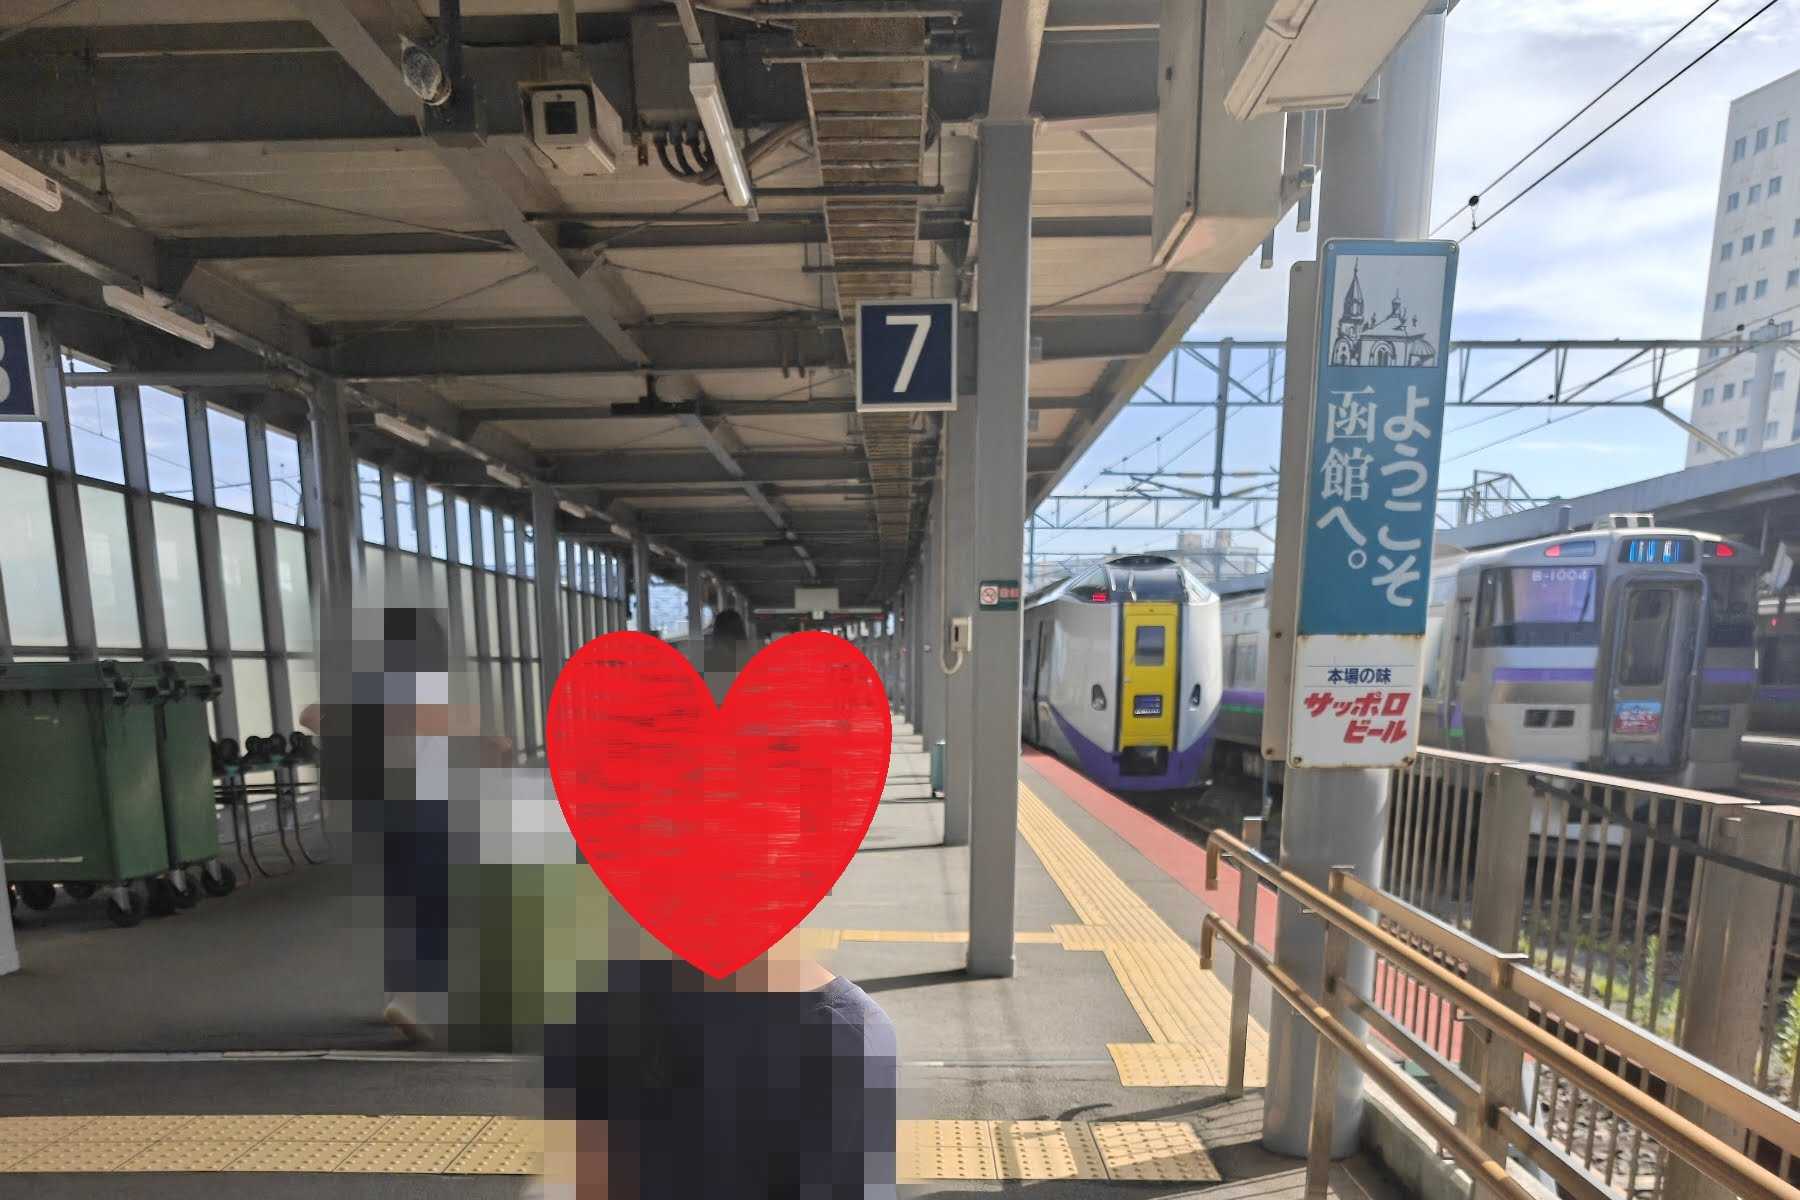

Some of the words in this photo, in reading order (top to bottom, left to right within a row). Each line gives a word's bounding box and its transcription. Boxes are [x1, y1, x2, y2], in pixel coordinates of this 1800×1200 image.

[885, 314, 932, 393] 7
[1315, 384, 1378, 571] 函館へ。
[1371, 384, 1431, 608] ようこそ
[1327, 667, 1392, 685] 本場の味
[1304, 690, 1411, 718] サッポロ
[1343, 719, 1408, 744] ビール
